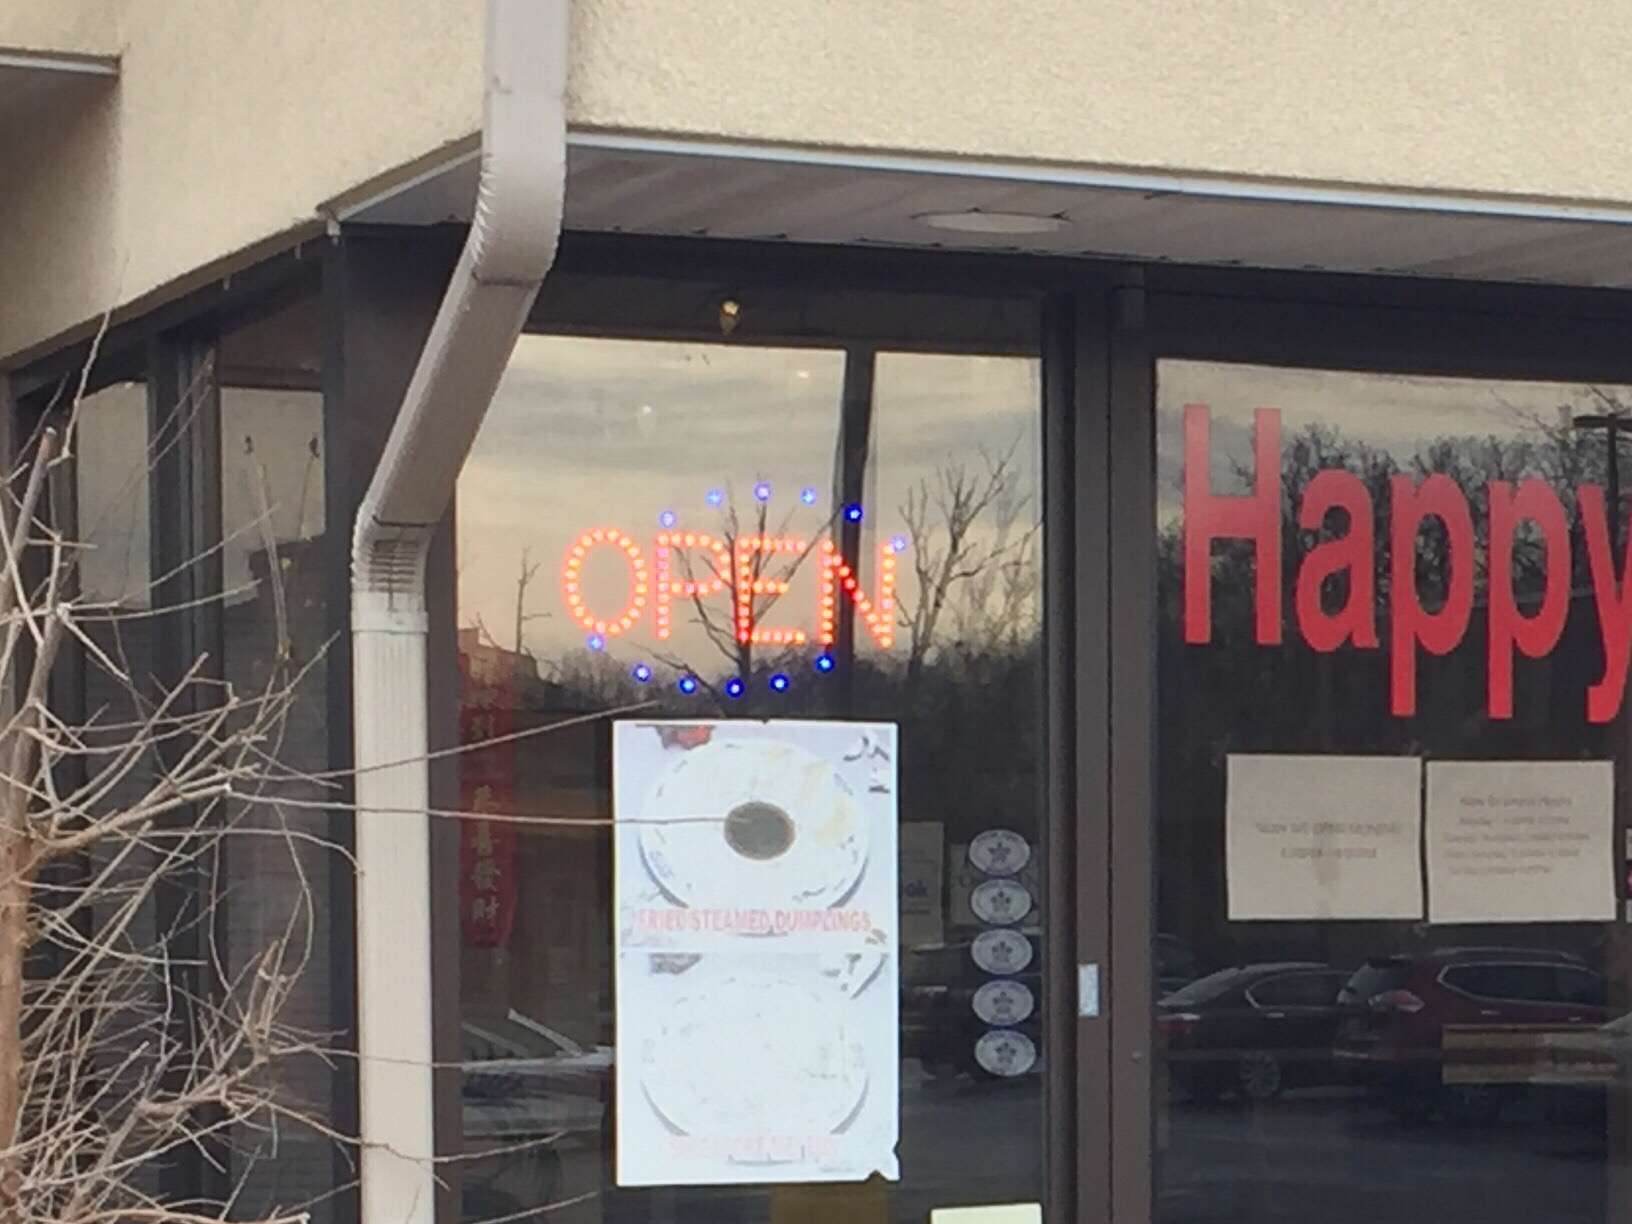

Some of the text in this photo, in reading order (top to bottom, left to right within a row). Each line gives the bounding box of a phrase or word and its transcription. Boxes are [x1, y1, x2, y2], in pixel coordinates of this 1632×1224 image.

[562, 526, 898, 648] OPEN
[688, 907, 769, 932] STEAMED
[774, 907, 873, 932] DUMPLINGS
